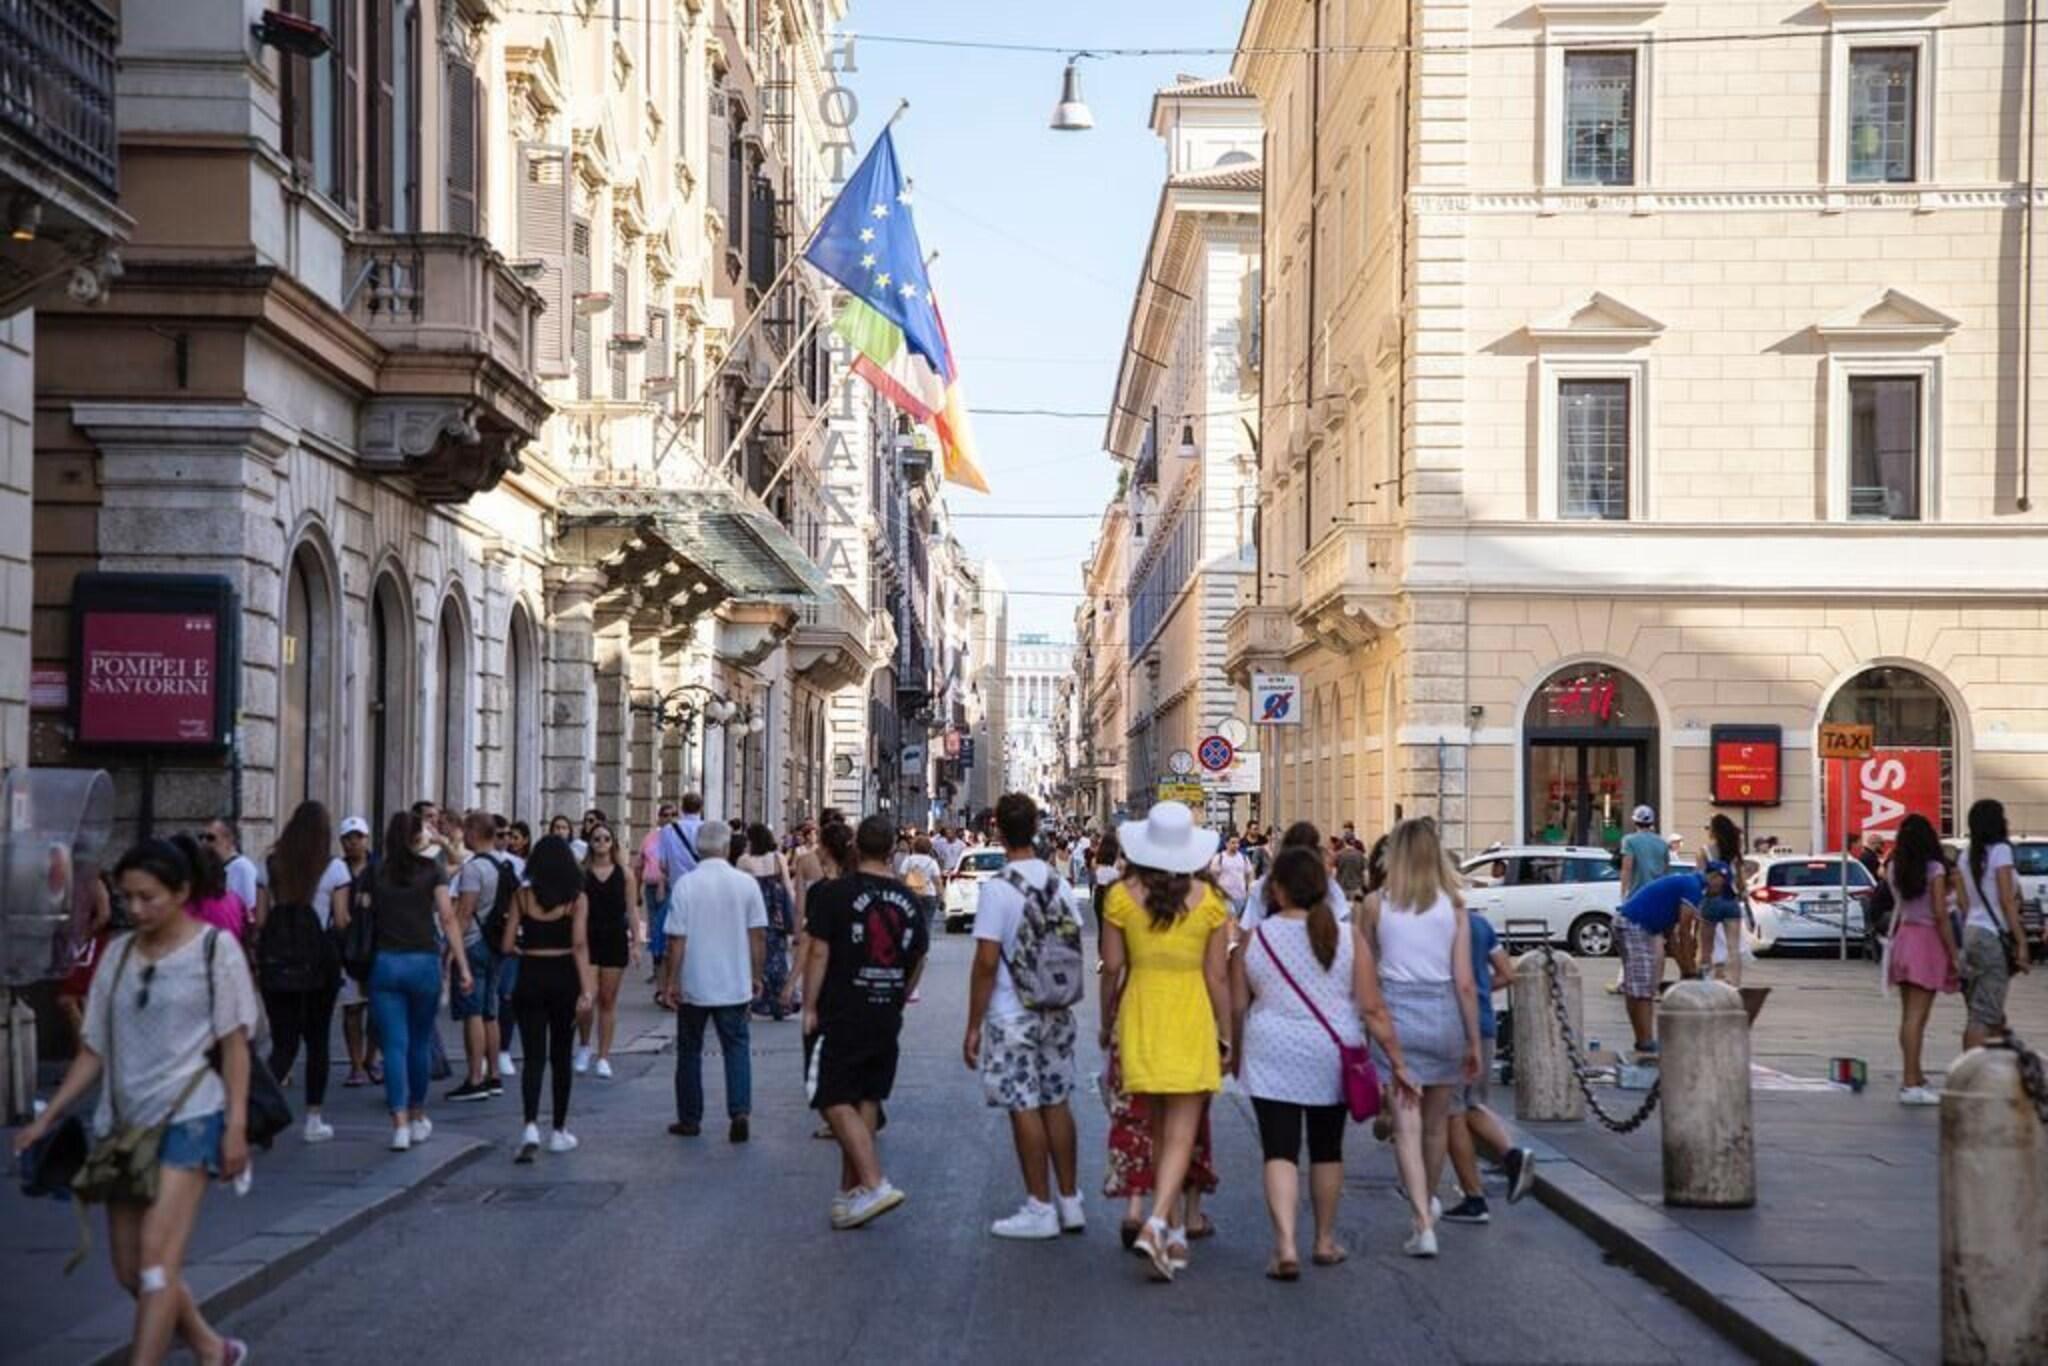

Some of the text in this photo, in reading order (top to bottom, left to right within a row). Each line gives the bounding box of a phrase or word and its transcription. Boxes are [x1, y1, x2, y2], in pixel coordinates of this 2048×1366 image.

[91, 657, 208, 677] POMPEI E
[88, 677, 208, 695] SANTORINI
[1823, 732, 1870, 750] TAXI
